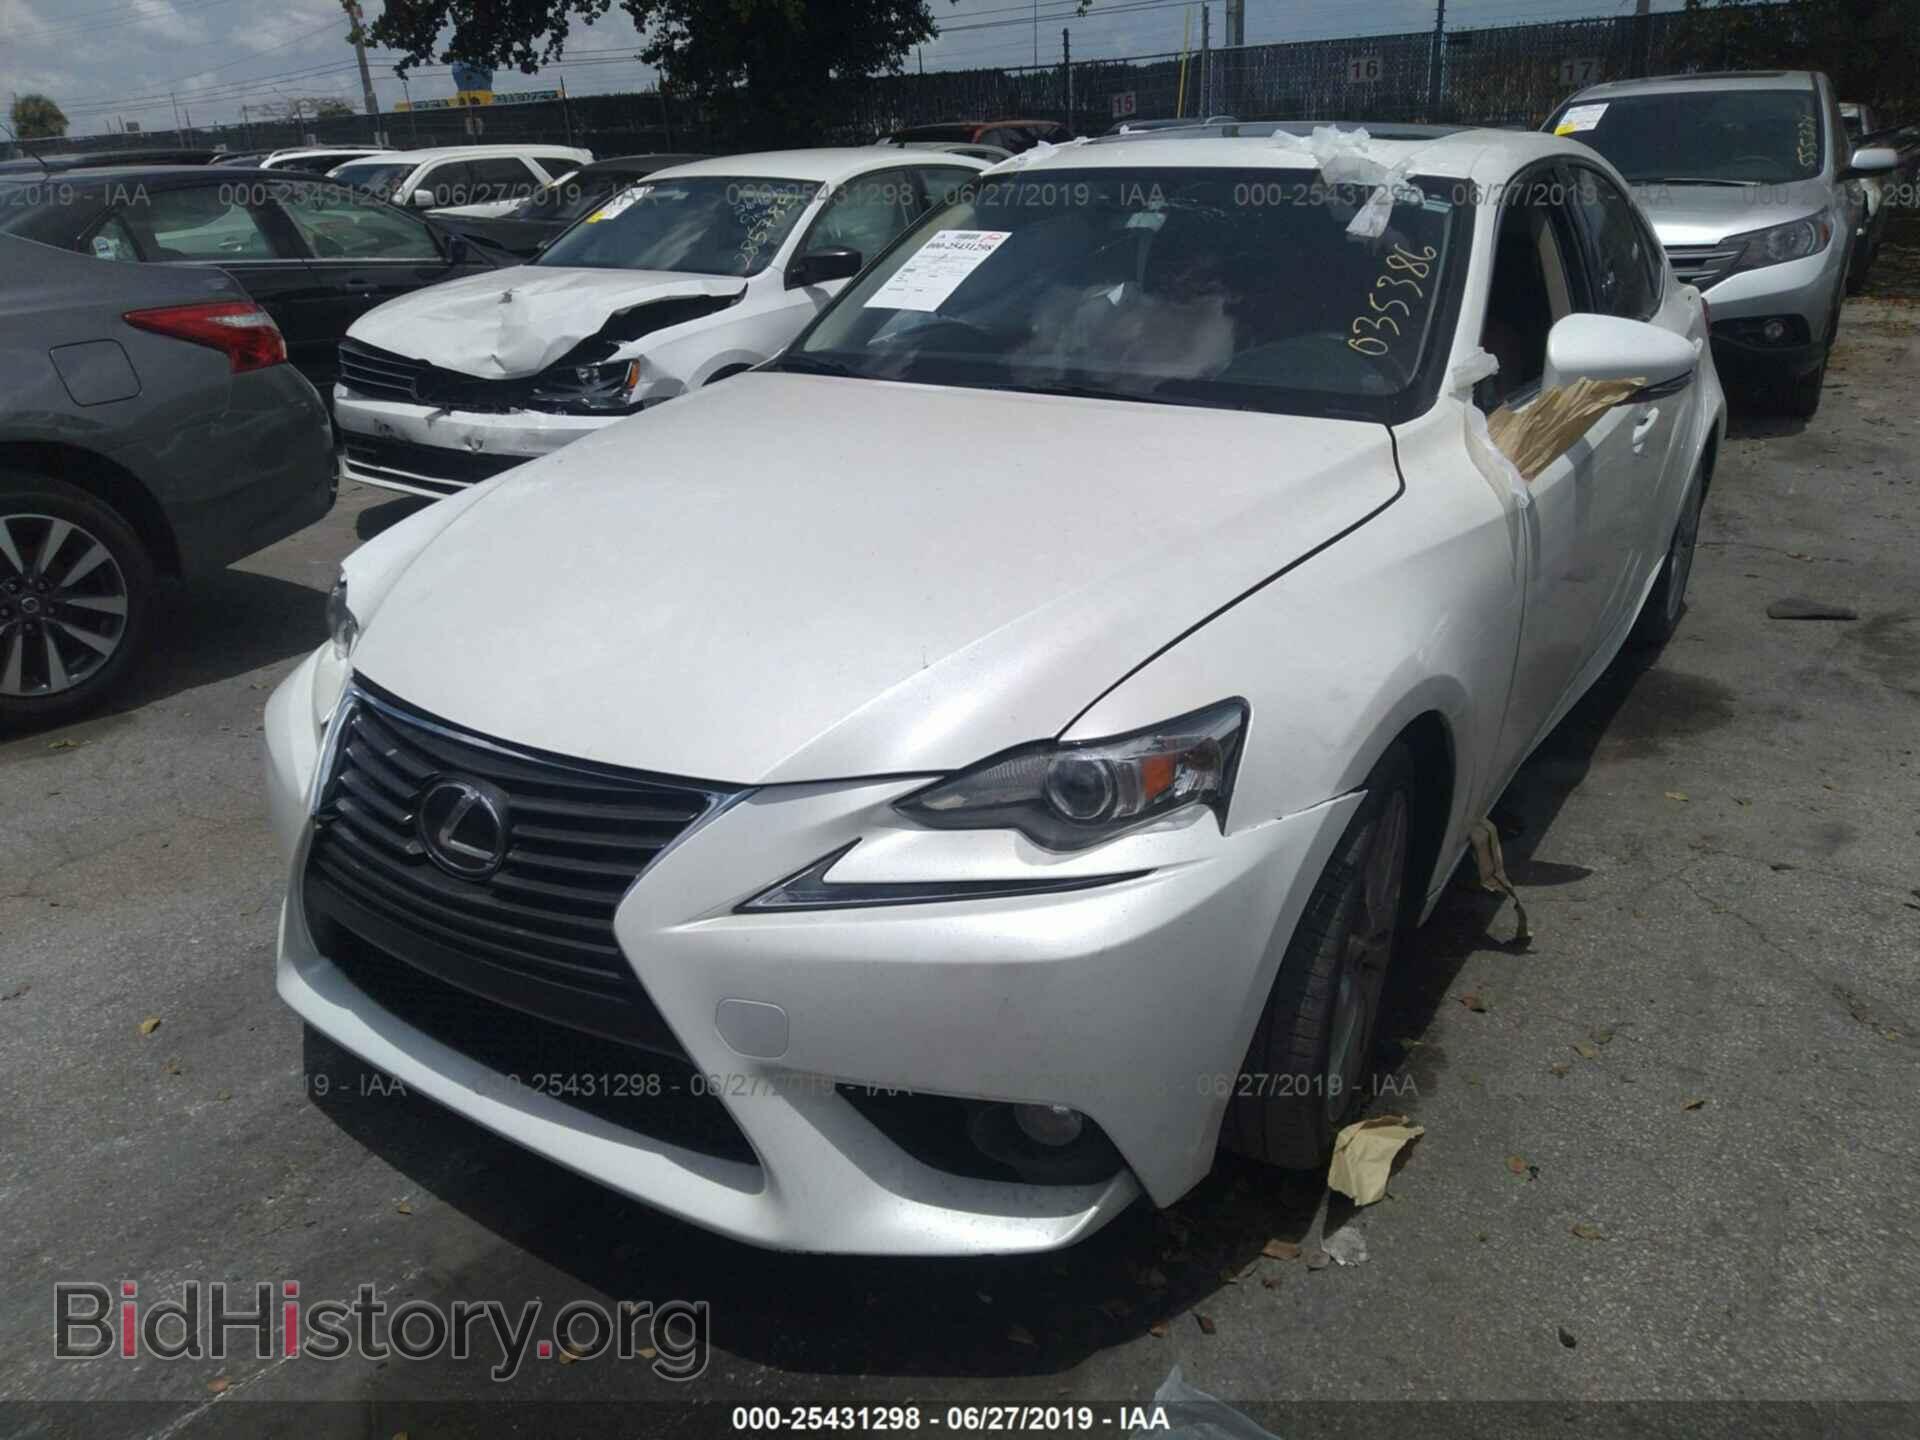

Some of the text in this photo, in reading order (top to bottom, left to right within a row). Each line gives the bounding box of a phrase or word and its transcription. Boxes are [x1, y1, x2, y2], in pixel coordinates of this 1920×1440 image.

[1351, 61, 1378, 81] 16
[1564, 61, 1593, 82] 17
[1113, 95, 1134, 113] 15
[1348, 242, 1438, 356] 035386
